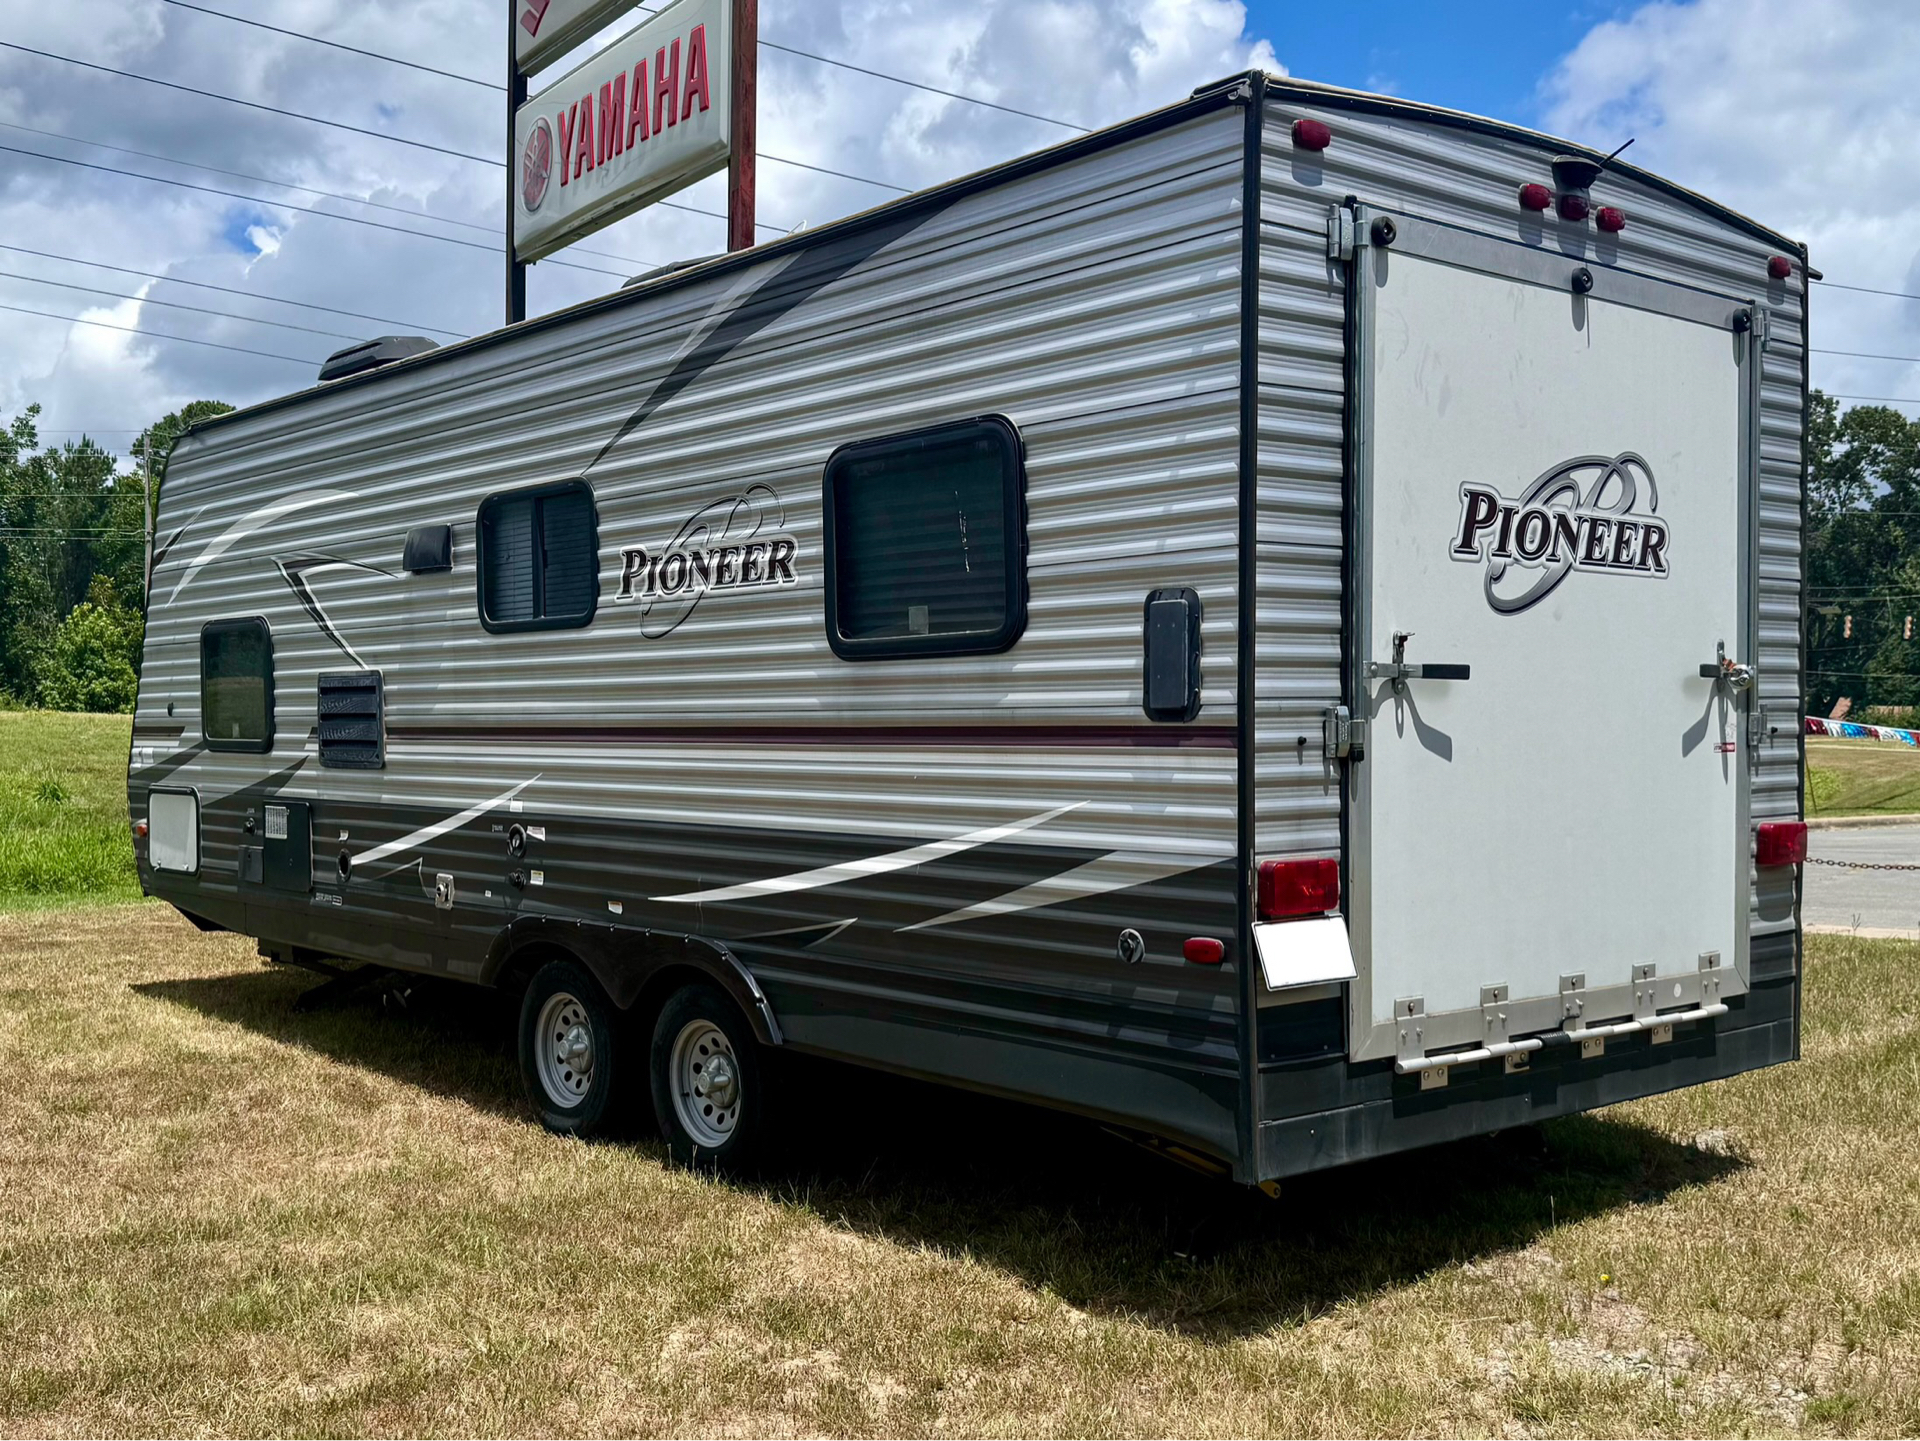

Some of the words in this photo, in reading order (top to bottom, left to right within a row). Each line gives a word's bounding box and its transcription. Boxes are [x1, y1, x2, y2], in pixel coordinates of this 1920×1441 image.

[557, 23, 710, 187] YAMAHA
[615, 538, 798, 600] PIONEER
[1452, 487, 1668, 574] PIONEER
